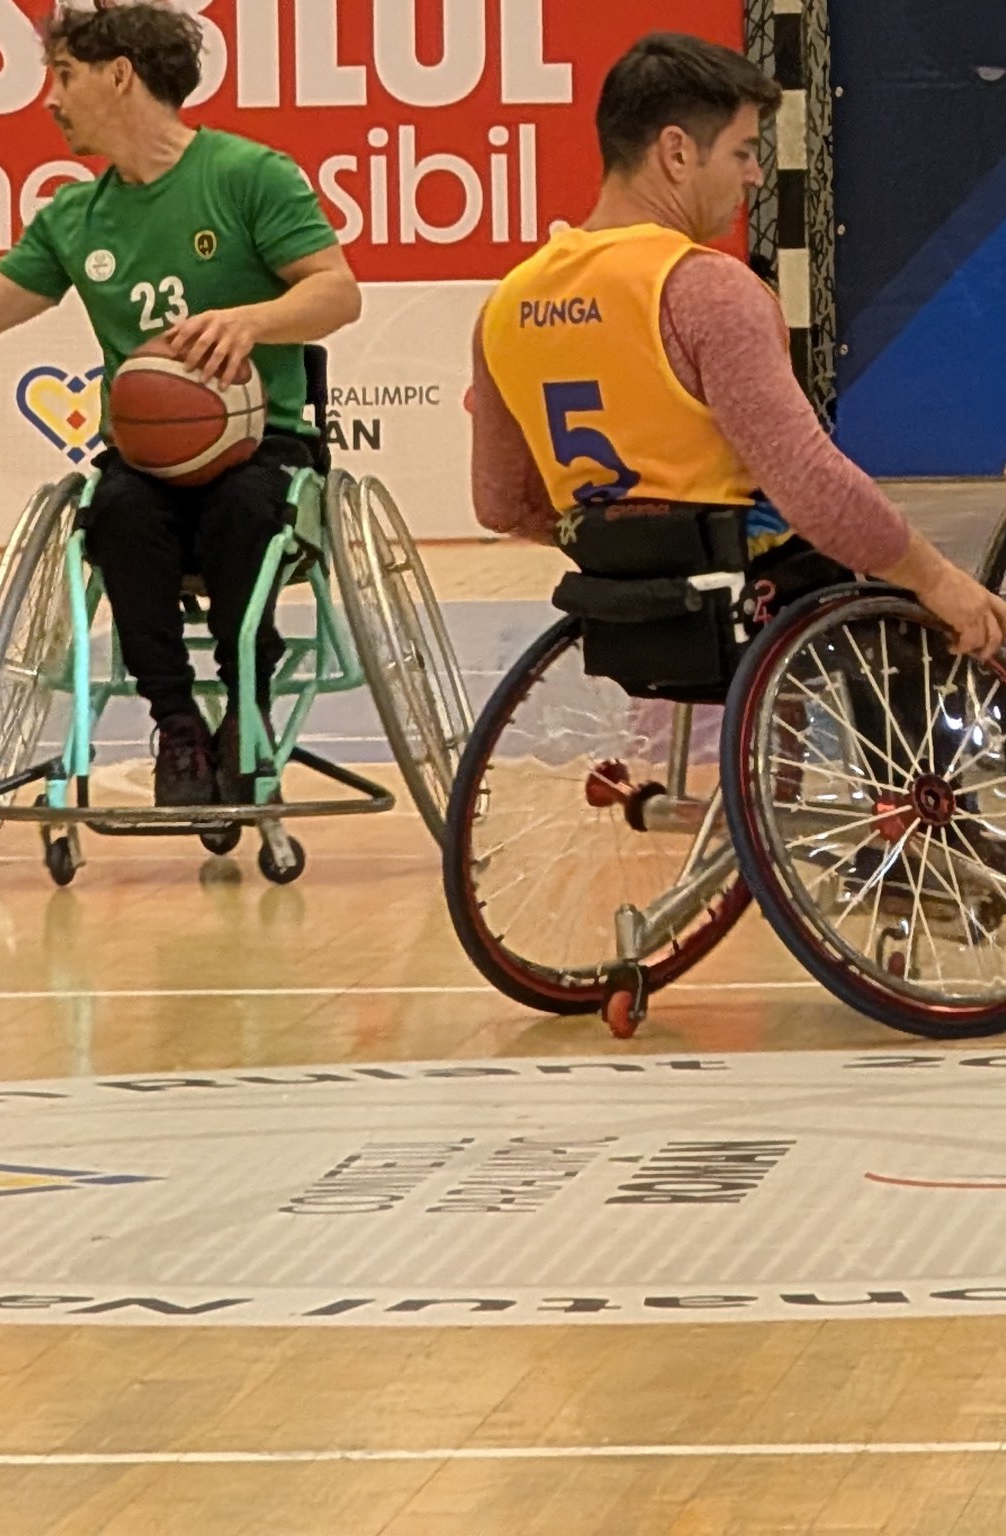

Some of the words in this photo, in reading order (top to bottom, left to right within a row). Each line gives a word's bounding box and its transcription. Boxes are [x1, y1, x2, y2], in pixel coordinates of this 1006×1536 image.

[130, 275, 189, 332] 23
[520, 297, 603, 328] PUNGA
[326, 385, 440, 407] RALIMPIC
[542, 379, 642, 506] 5
